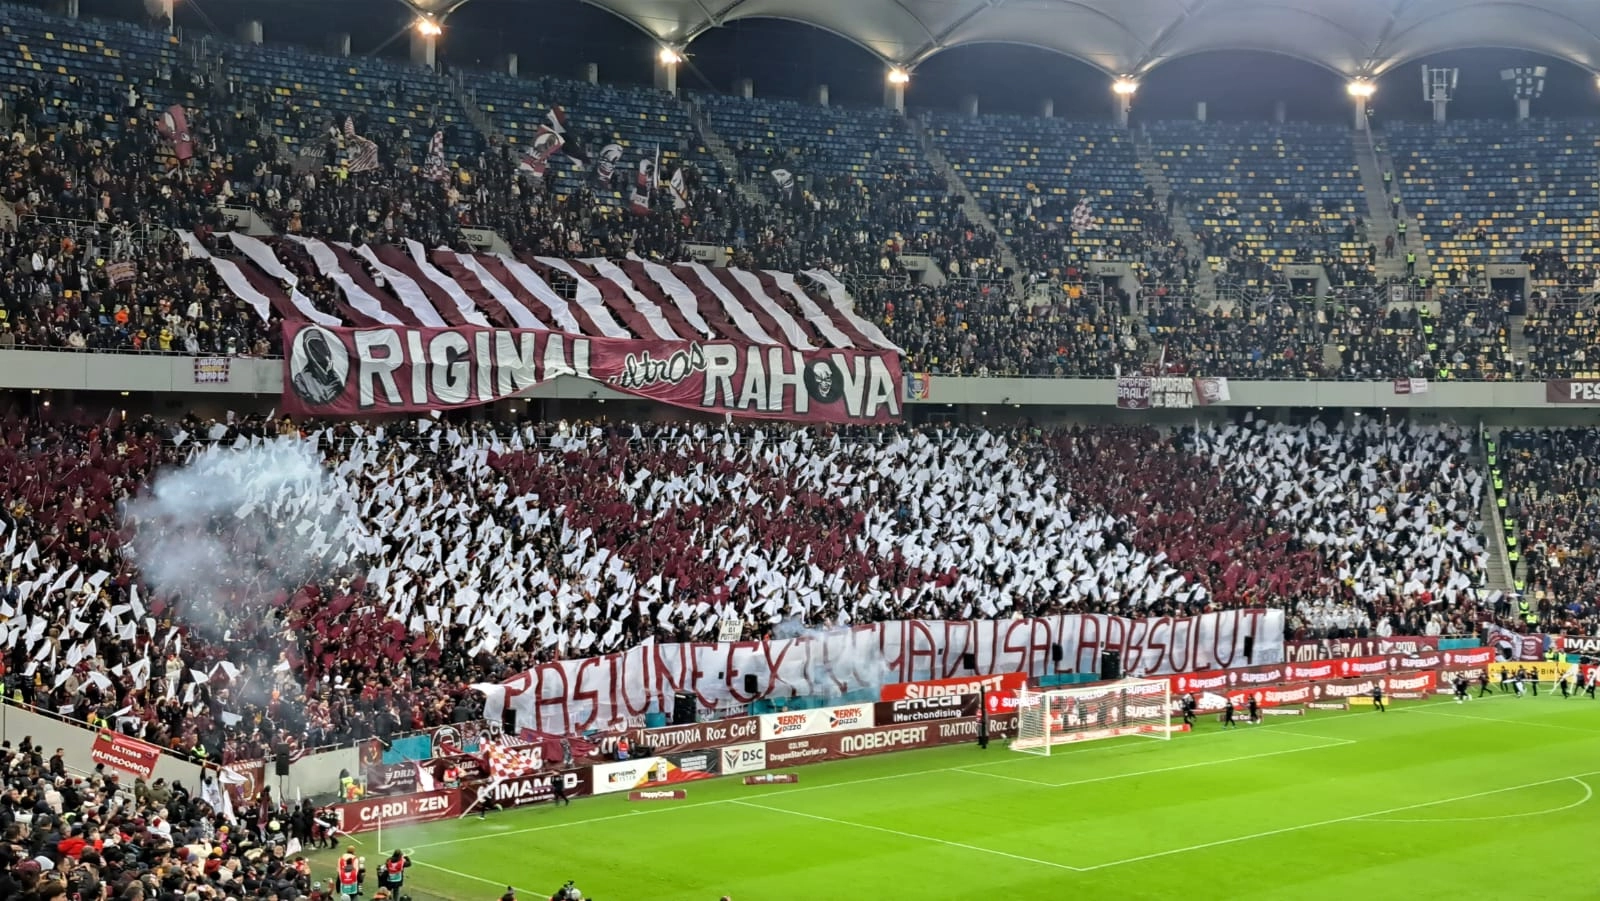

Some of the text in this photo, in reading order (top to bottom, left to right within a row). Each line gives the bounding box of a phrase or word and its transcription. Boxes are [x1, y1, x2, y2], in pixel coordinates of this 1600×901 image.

[1105, 608, 1267, 674] ABSOLUT
[1352, 660, 1387, 672] SUPERBET
[1454, 652, 1490, 664] SUPERBET
[1189, 665, 1332, 688] SUPERBET SUPERLIGA SUPERBET
[1265, 687, 1310, 702] SUPERBET
[1389, 675, 1429, 689] SUPERBET
[894, 709, 961, 722] iMerchandising
[645, 727, 701, 748] TRATTORIA
[706, 727, 727, 741] Roz
[730, 720, 757, 738] Café
[841, 726, 929, 753] MOBEXPERT
[939, 721, 977, 737] TRATTOR
[989, 719, 1008, 732] Roz
[742, 749, 764, 762] DSC
